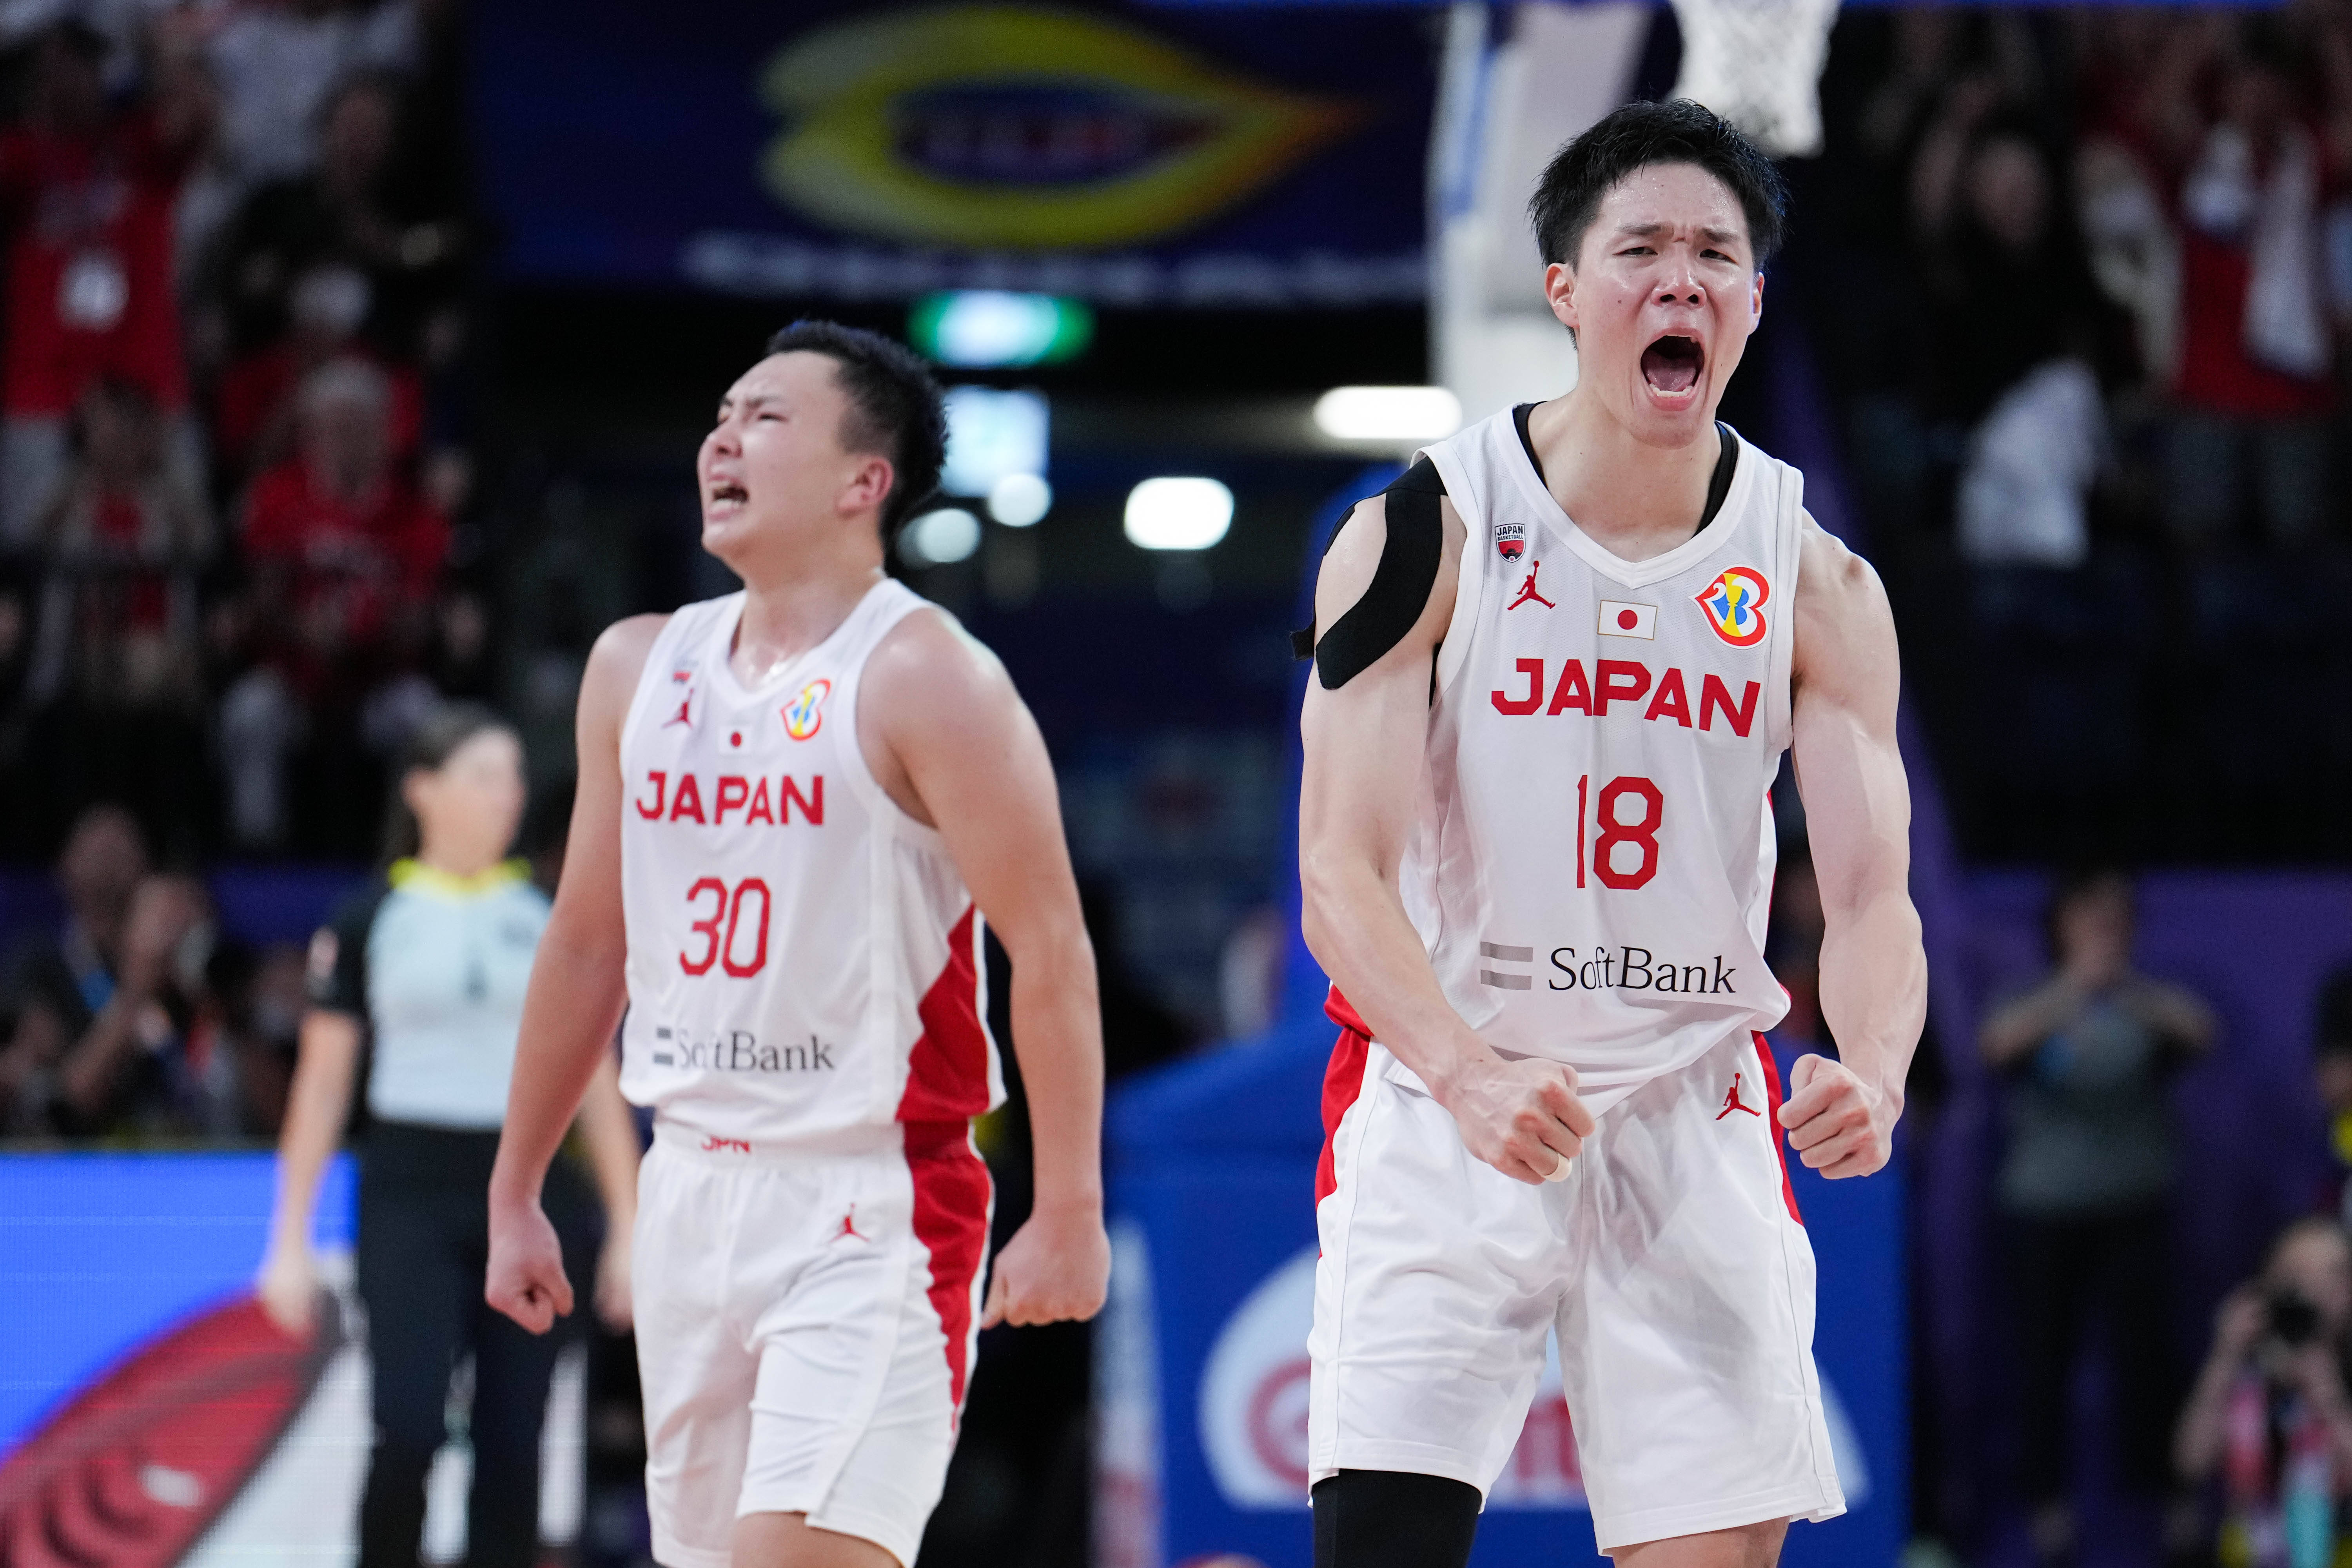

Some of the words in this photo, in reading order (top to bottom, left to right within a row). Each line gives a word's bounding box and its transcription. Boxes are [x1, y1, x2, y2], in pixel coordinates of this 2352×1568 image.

[1497, 526, 1523, 536] JAPAN
[1491, 658, 1761, 737] JAPAN
[636, 770, 824, 826] JAPAN
[1577, 775, 1664, 890] 18
[679, 877, 771, 978] 30
[1548, 946, 1737, 994] SoftBank
[677, 1028, 835, 1073] SotBank
